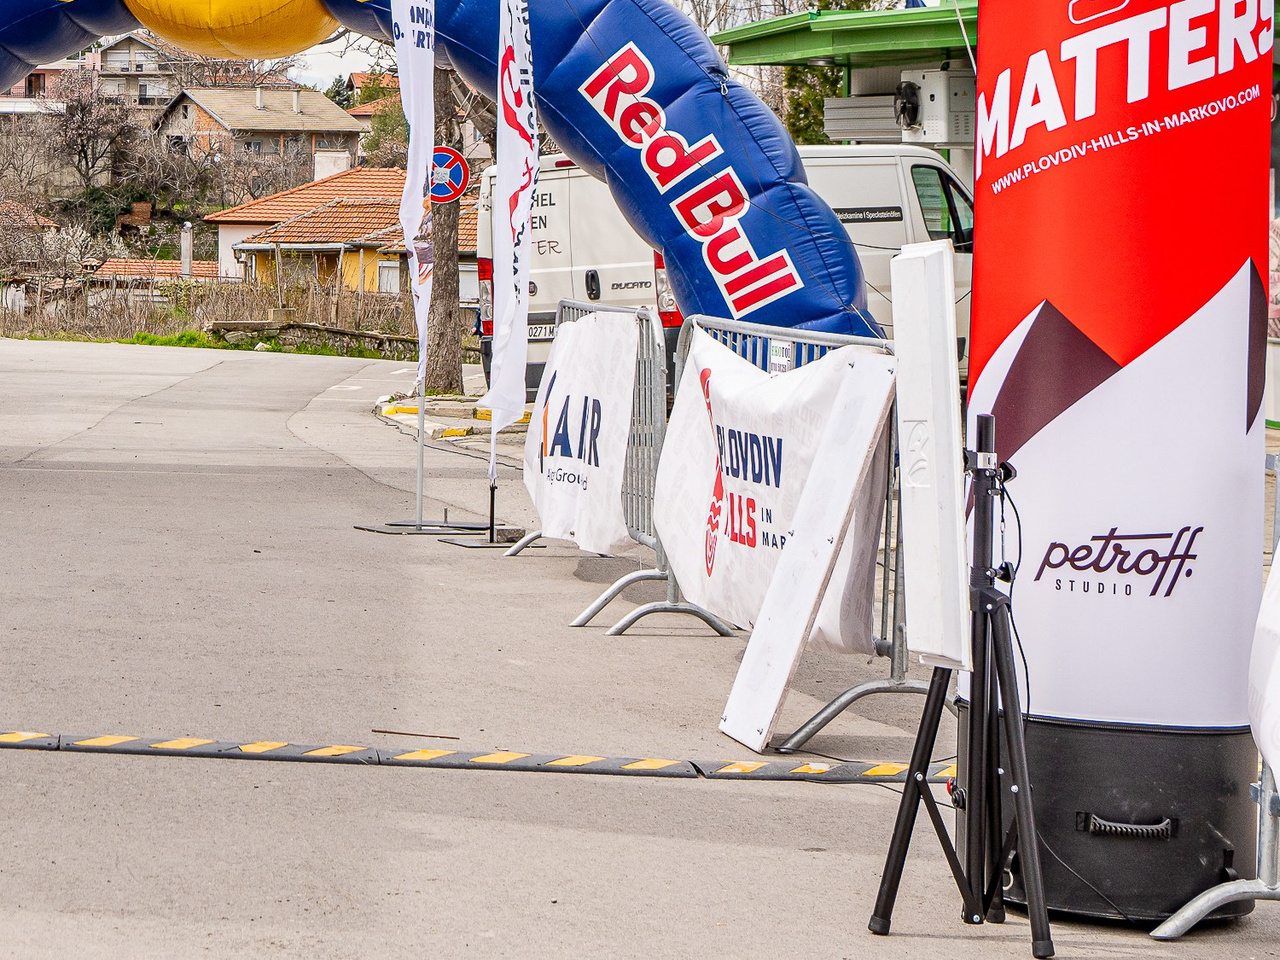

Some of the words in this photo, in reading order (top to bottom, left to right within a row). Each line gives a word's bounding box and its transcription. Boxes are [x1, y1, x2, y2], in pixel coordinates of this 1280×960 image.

[991, 84, 1261, 195] WWW.PLOVDIV-HILLS-IN-MARKOVO.COM
[582, 45, 721, 191] Red
[673, 169, 800, 315] Bull
[611, 281, 652, 290] DUCATO
[716, 424, 783, 489] PLOVDIV
[761, 507, 772, 524] IN
[1034, 526, 1204, 597] petroff.
[1055, 578, 1133, 596] STUDIO
